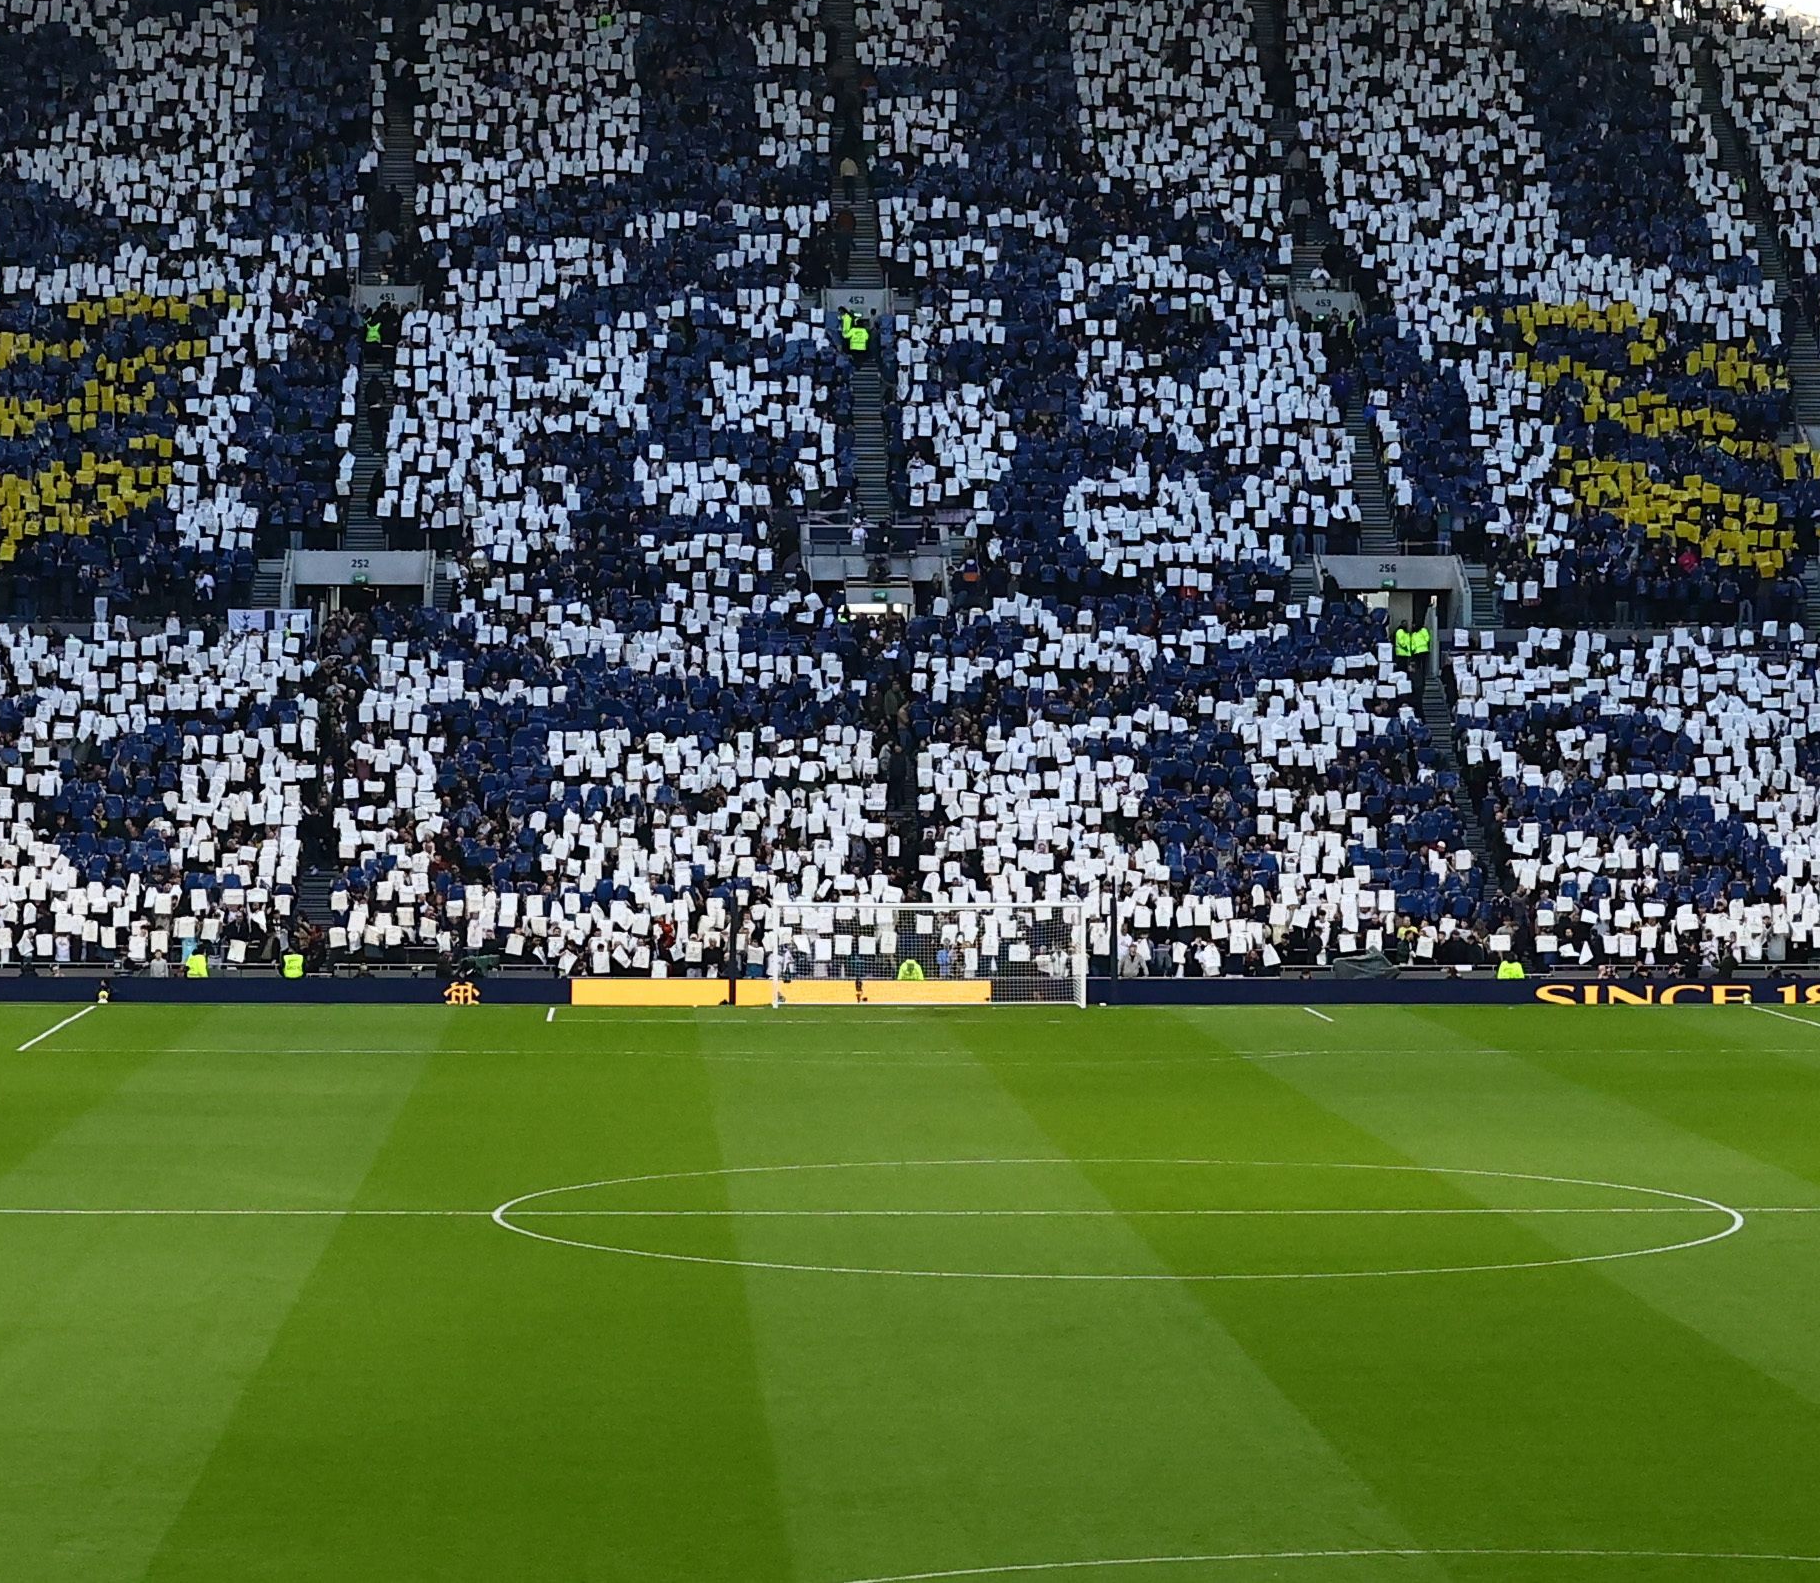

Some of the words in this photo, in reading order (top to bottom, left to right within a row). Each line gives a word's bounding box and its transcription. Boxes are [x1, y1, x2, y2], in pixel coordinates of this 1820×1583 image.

[380, 293, 396, 301] 451
[849, 296, 865, 304] 452
[1315, 299, 1331, 307] 453
[351, 559, 369, 568] 252
[1379, 564, 1396, 573] 256
